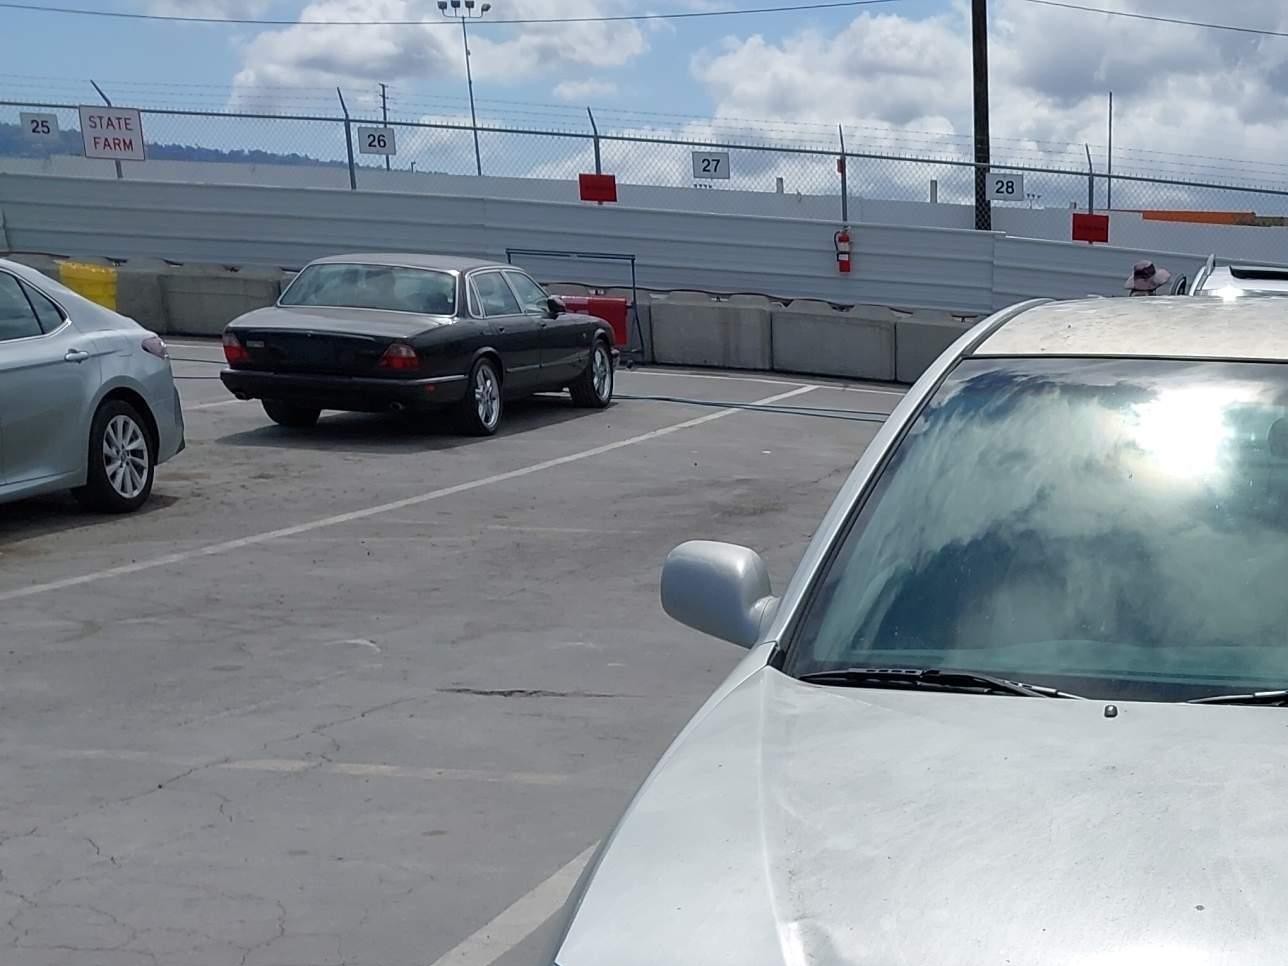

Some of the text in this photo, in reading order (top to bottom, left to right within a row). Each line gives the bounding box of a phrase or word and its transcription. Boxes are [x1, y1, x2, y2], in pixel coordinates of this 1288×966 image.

[31, 119, 51, 134] 25
[88, 115, 133, 131] STATE
[93, 136, 134, 152] FARM
[367, 133, 387, 148] 26
[701, 158, 721, 173] 27
[995, 179, 1015, 195] 28
